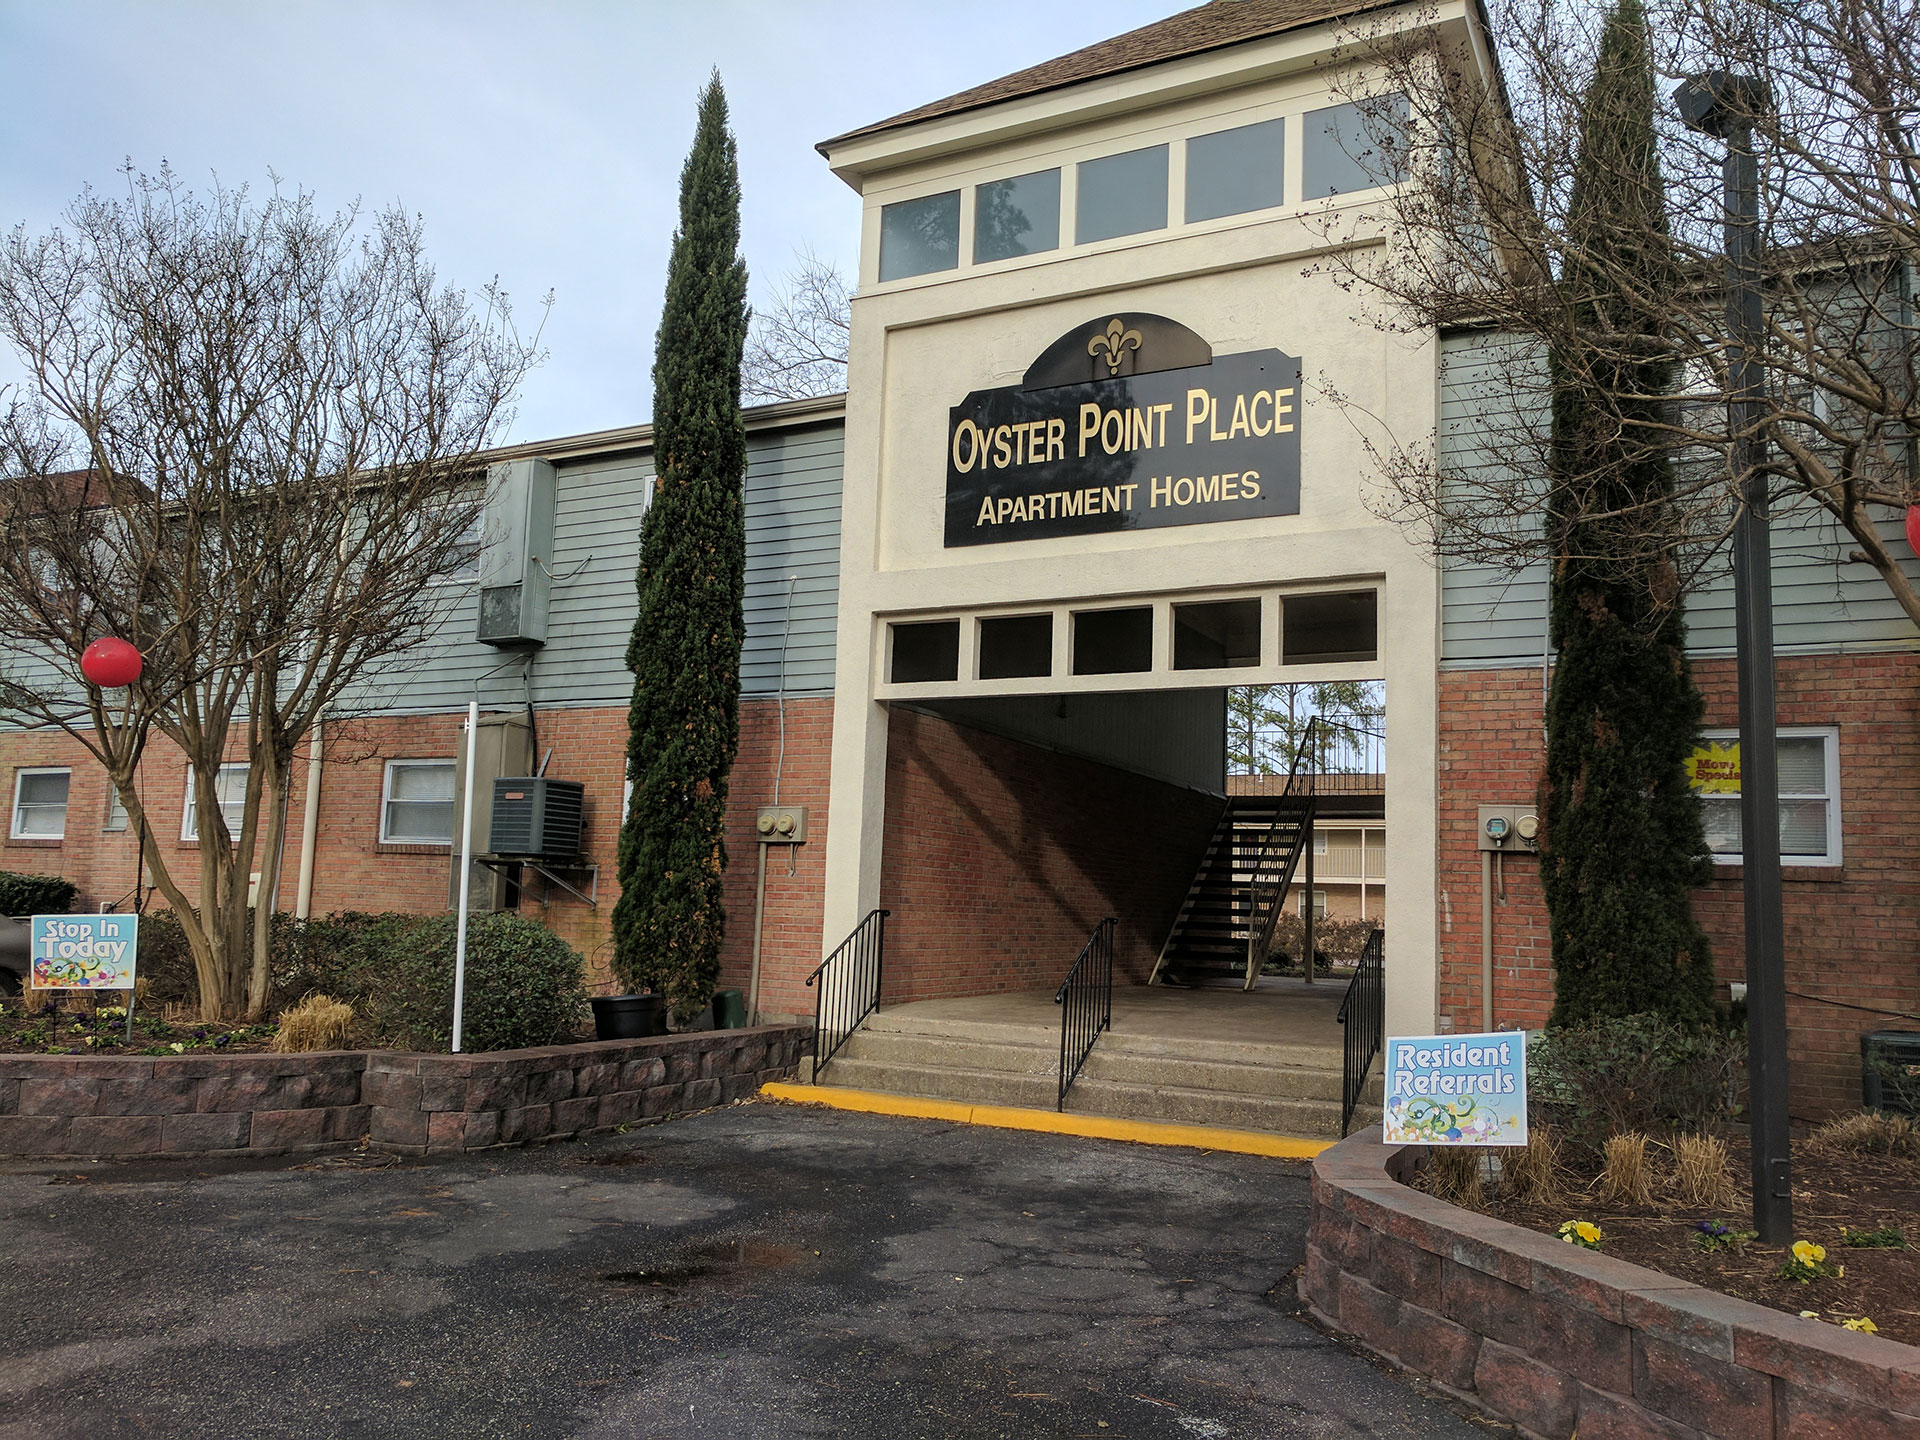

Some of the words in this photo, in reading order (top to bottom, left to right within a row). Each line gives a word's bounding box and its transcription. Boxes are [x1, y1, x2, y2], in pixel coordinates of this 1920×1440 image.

[952, 418, 1066, 474] OYSTER
[1078, 402, 1173, 458] POINT
[1185, 387, 1295, 445] PLACE
[976, 483, 1139, 526] APARTMENT
[1150, 470, 1261, 509] HOMES
[1695, 769, 1741, 782] Specia
[1696, 759, 1735, 769] Move
[45, 920, 92, 942] Stop
[100, 919, 119, 937] In
[39, 936, 128, 963] Today
[1396, 1041, 1512, 1071] Resident
[1394, 1068, 1516, 1098] Referrals
